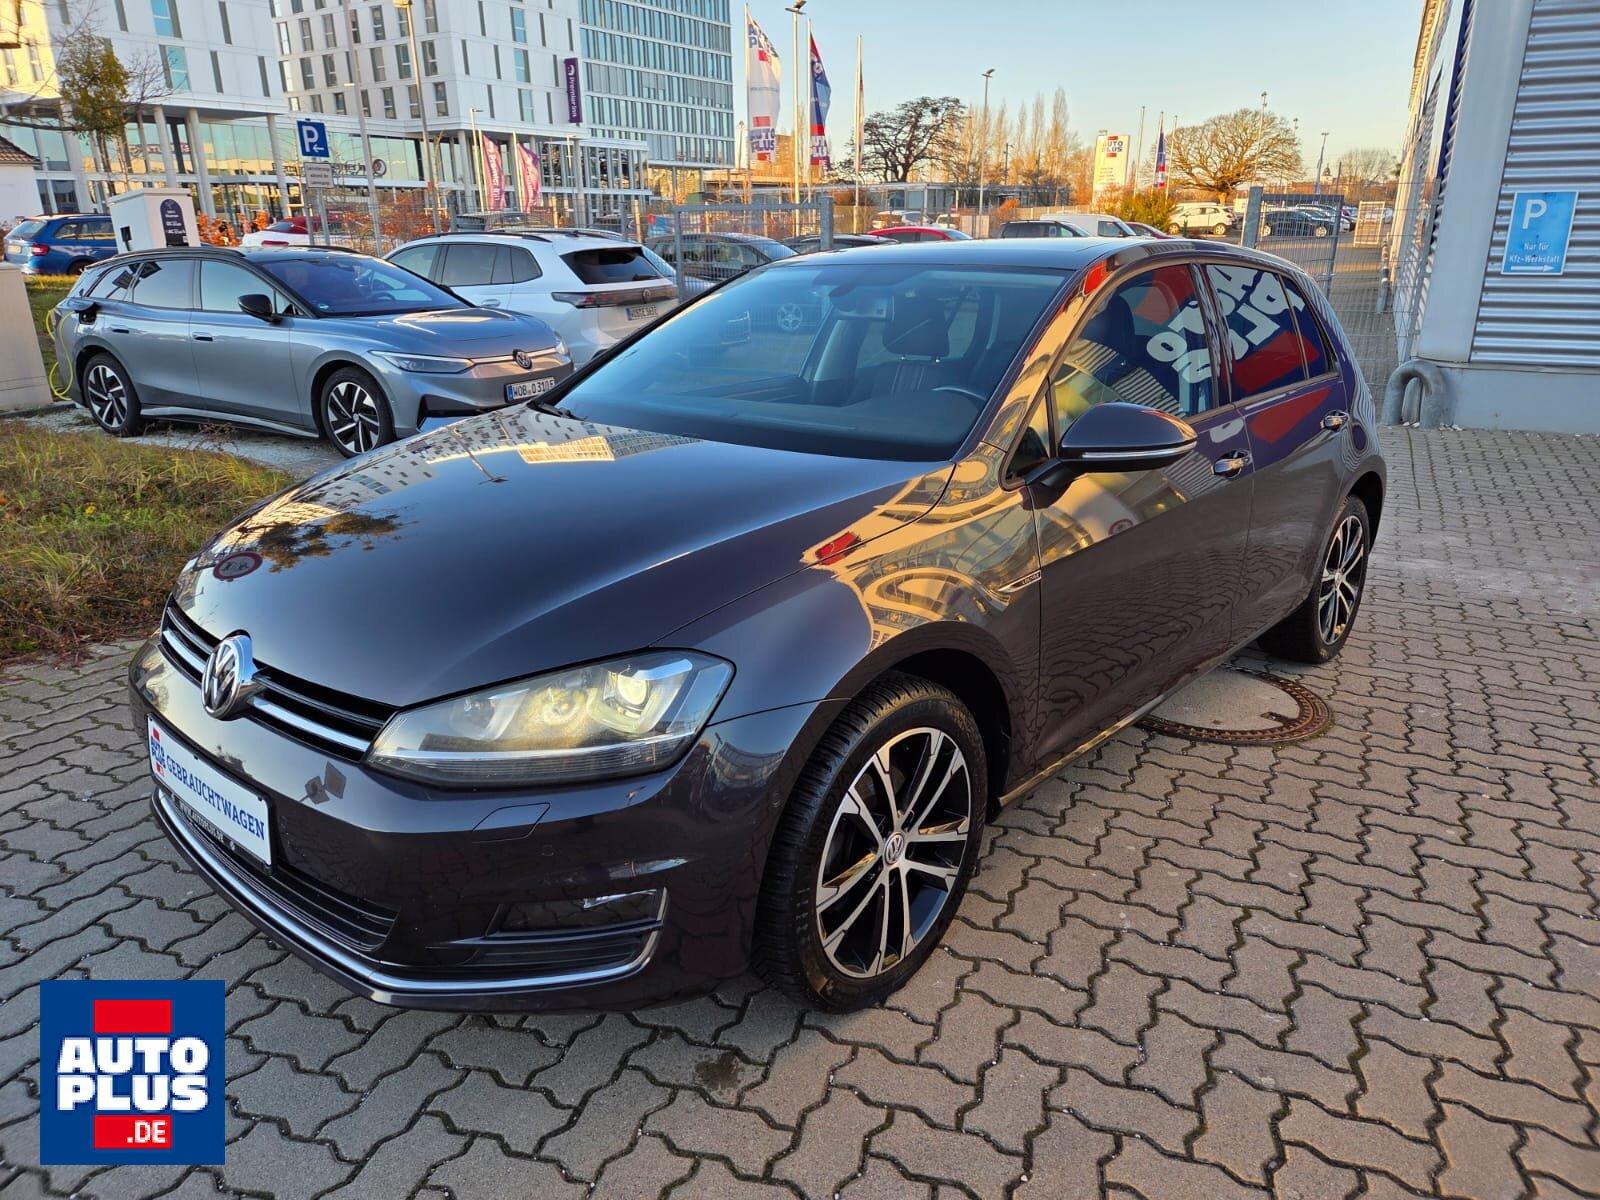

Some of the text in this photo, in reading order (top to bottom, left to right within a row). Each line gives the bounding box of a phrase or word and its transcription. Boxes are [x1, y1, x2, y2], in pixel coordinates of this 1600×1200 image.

[302, 125, 319, 153] P
[1522, 198, 1548, 230] P
[1509, 254, 1560, 263] Kfz-Werkstatt
[1524, 242, 1550, 251] Nur für
[166, 755, 265, 841] GEBRAUCHTWAGEN
